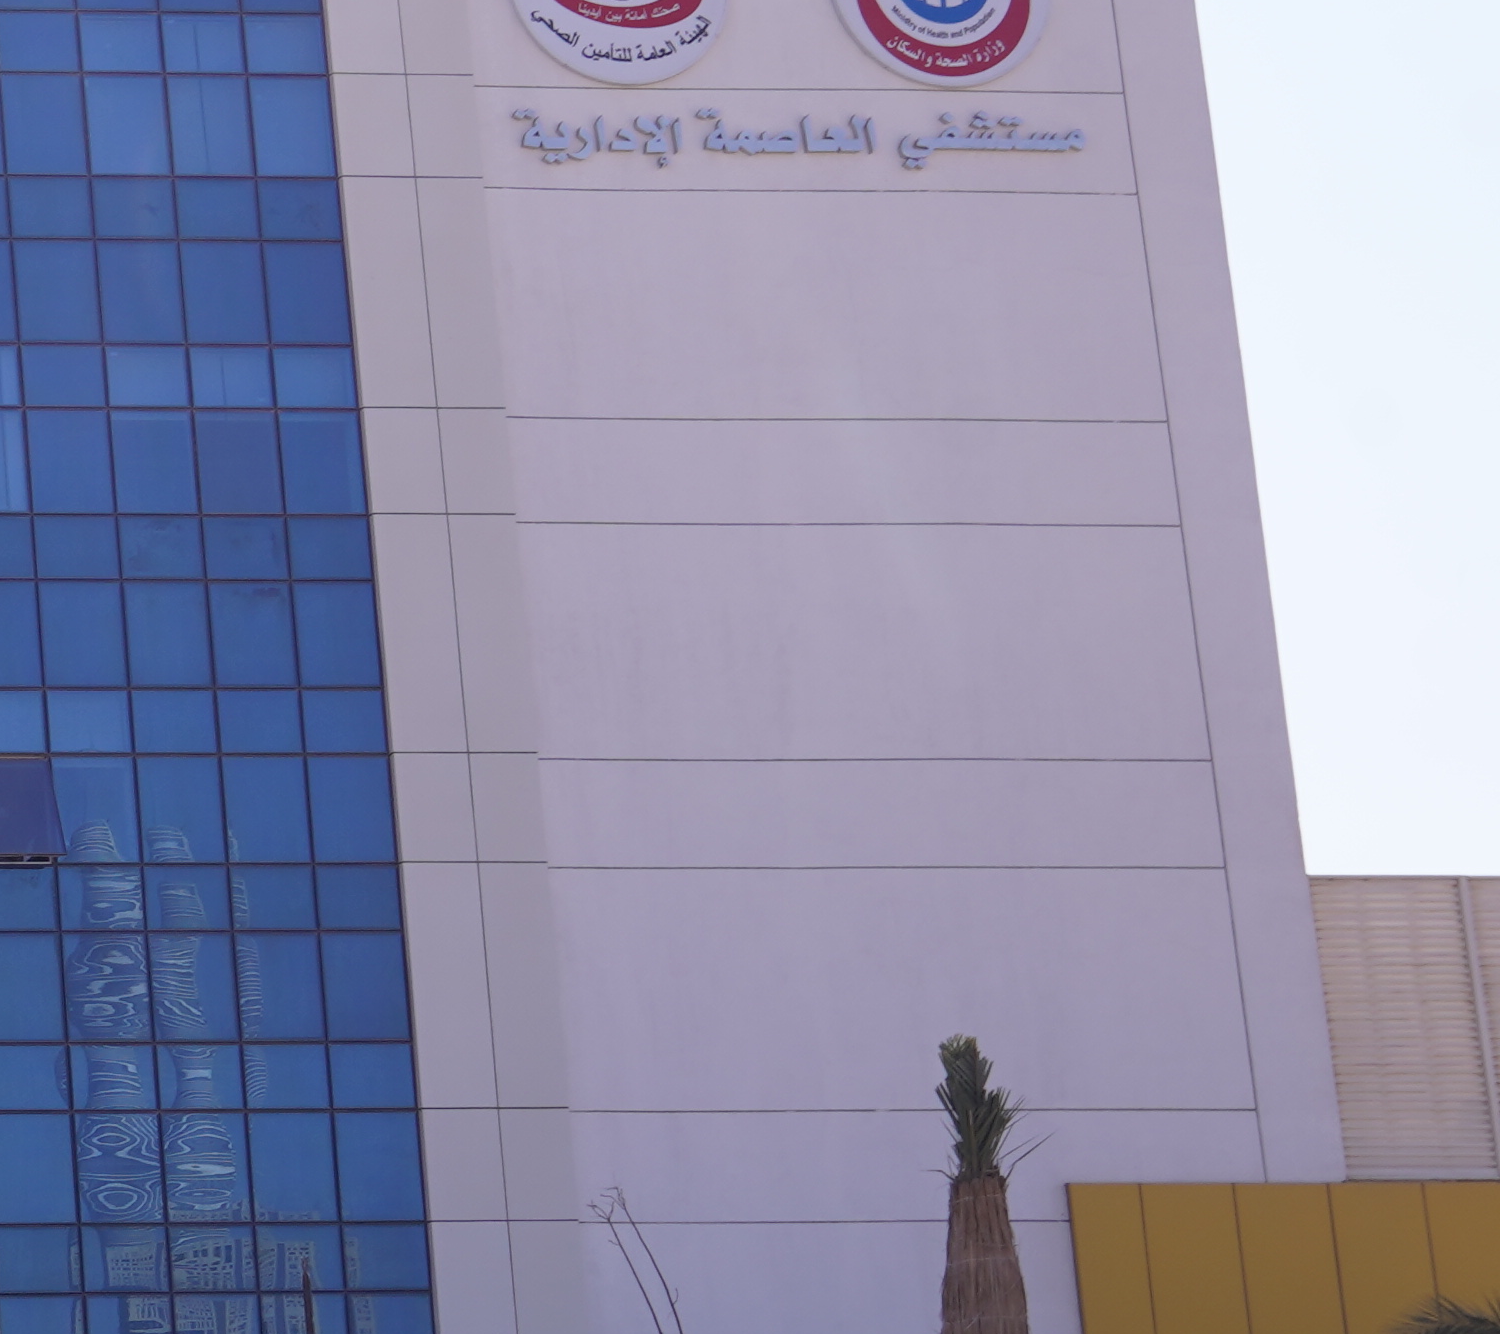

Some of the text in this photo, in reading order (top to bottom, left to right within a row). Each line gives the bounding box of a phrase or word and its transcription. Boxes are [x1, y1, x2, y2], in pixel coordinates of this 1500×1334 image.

[674, 15, 712, 46] الهيئة
[891, 5, 996, 39] Ministry of Health and Population
[637, 40, 678, 61] العامة
[935, 51, 972, 67] الصحة
[973, 39, 1006, 63] وزارة
[511, 108, 683, 169] الإدارية
[694, 107, 876, 155] العاصمة
